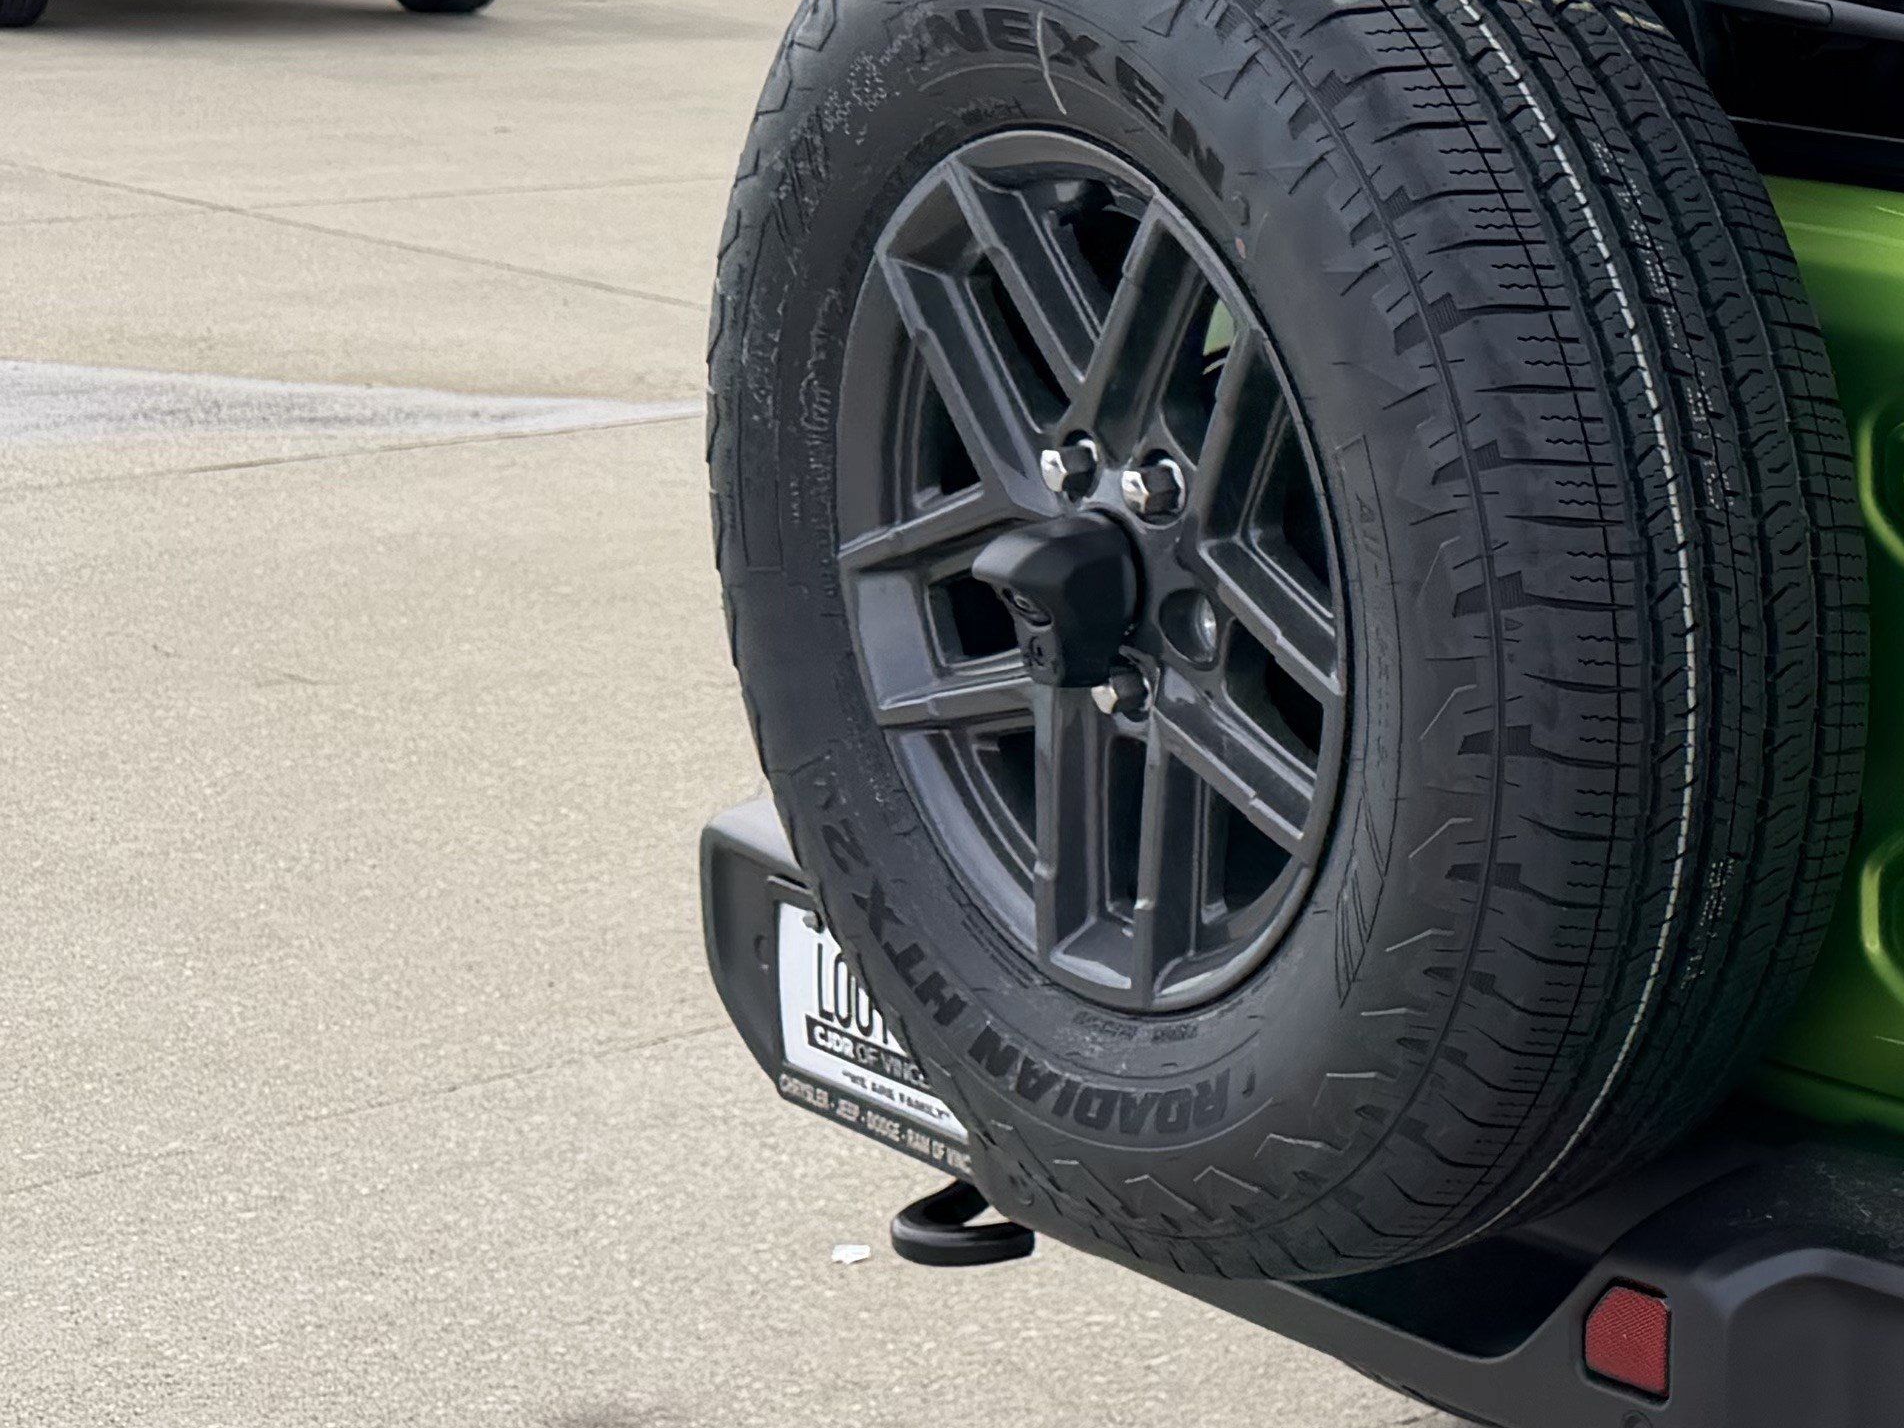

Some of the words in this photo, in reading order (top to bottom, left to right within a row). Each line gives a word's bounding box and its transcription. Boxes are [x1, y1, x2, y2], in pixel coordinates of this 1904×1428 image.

[920, 7, 1226, 203] NEXEN
[813, 1025, 856, 1061] CJDR
[966, 1023, 1231, 1137] ROADIAN
